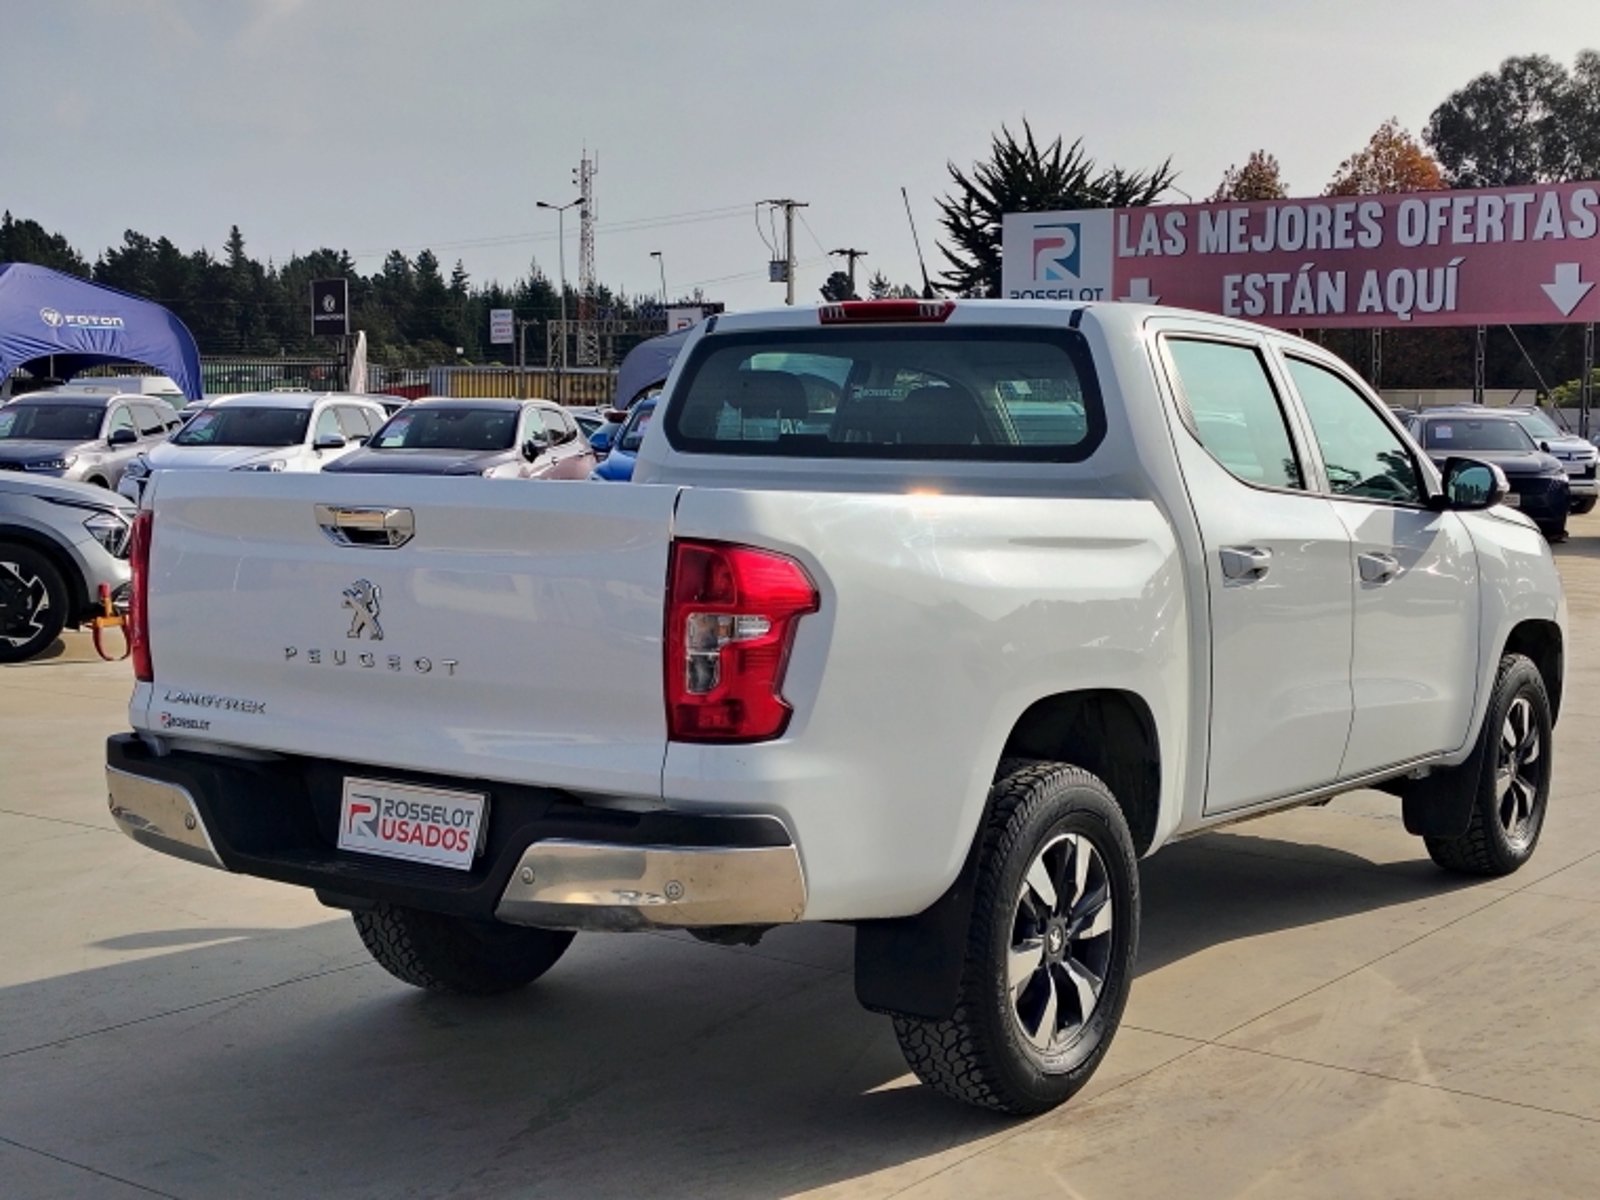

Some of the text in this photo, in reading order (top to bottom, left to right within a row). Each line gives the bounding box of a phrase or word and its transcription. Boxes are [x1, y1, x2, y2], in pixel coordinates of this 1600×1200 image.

[1118, 188, 1600, 258] LAS MEJORES OFERTAS
[1223, 256, 1467, 321] ESTÁN AQUÍ
[284, 646, 459, 676] PEUGEOT
[163, 690, 267, 714] LANDTREK
[383, 799, 475, 828] ROSSELOT
[381, 818, 471, 851] USADOS
